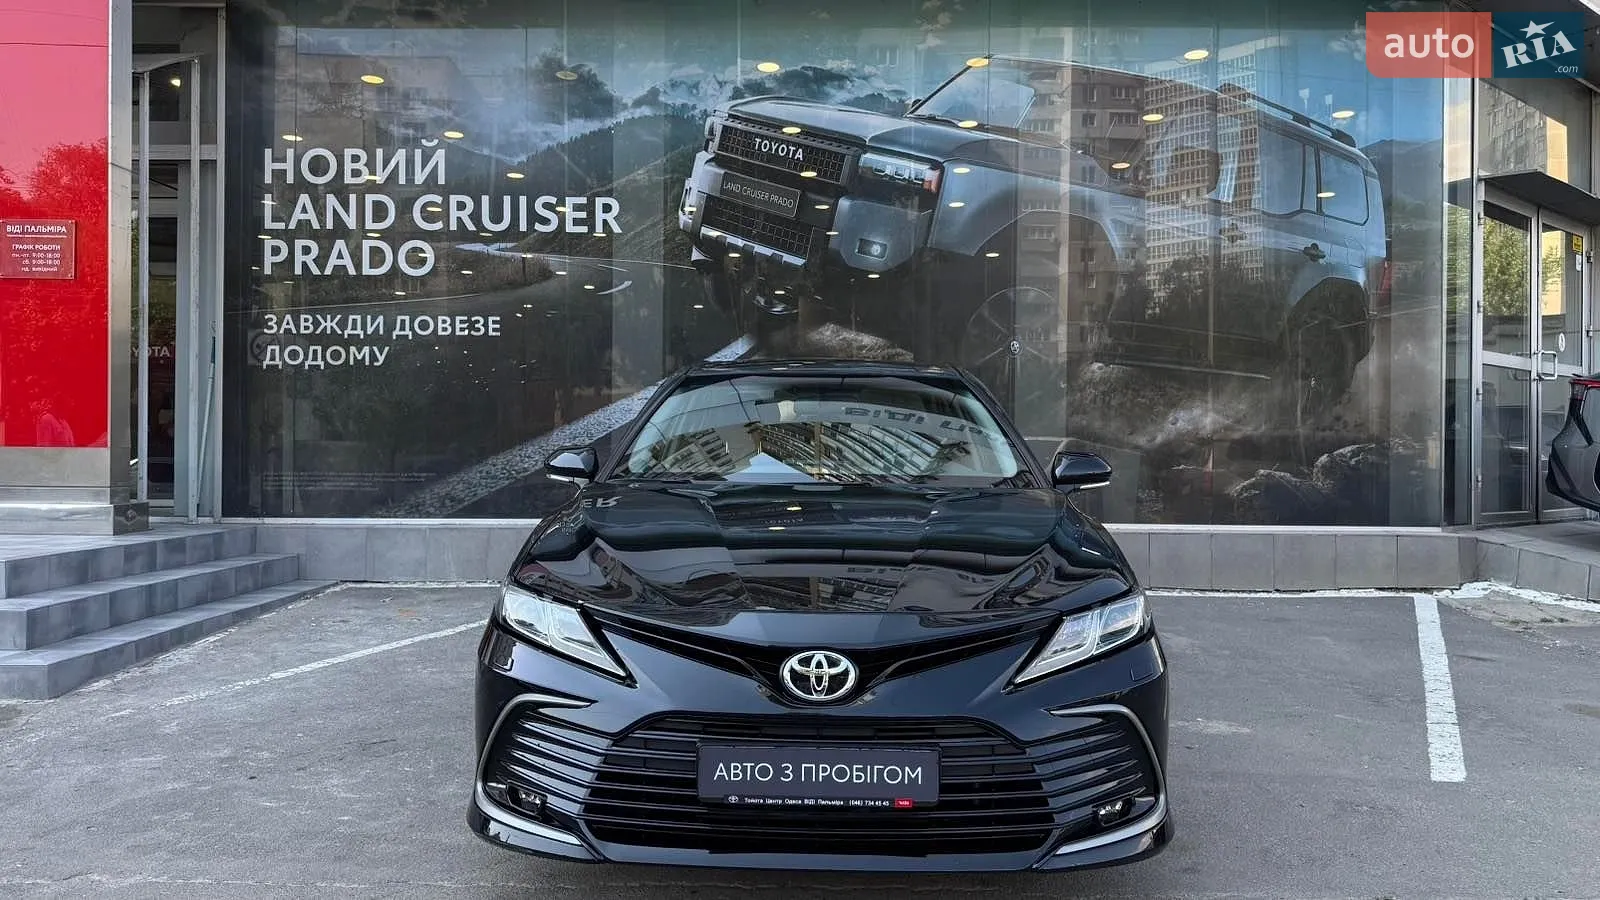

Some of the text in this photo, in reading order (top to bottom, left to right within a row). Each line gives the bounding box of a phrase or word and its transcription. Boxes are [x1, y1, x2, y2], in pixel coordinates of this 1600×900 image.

[264, 139, 446, 185] НОВИЙ
[754, 138, 804, 161] TOYOTA
[723, 181, 794, 209] LAND CRUISER PRADO
[264, 194, 623, 234] LAND CRUISER
[6, 225, 67, 234] ВІДІ ПАЛЬМІРА
[264, 239, 435, 277] PRADO
[263, 314, 501, 341] ЗАВЖДИ ДОВЕЗЕ
[130, 346, 170, 357] YOTA
[263, 345, 390, 370] ДОДОМУ
[713, 762, 923, 785] АВТО З ПРОБІГОМ
